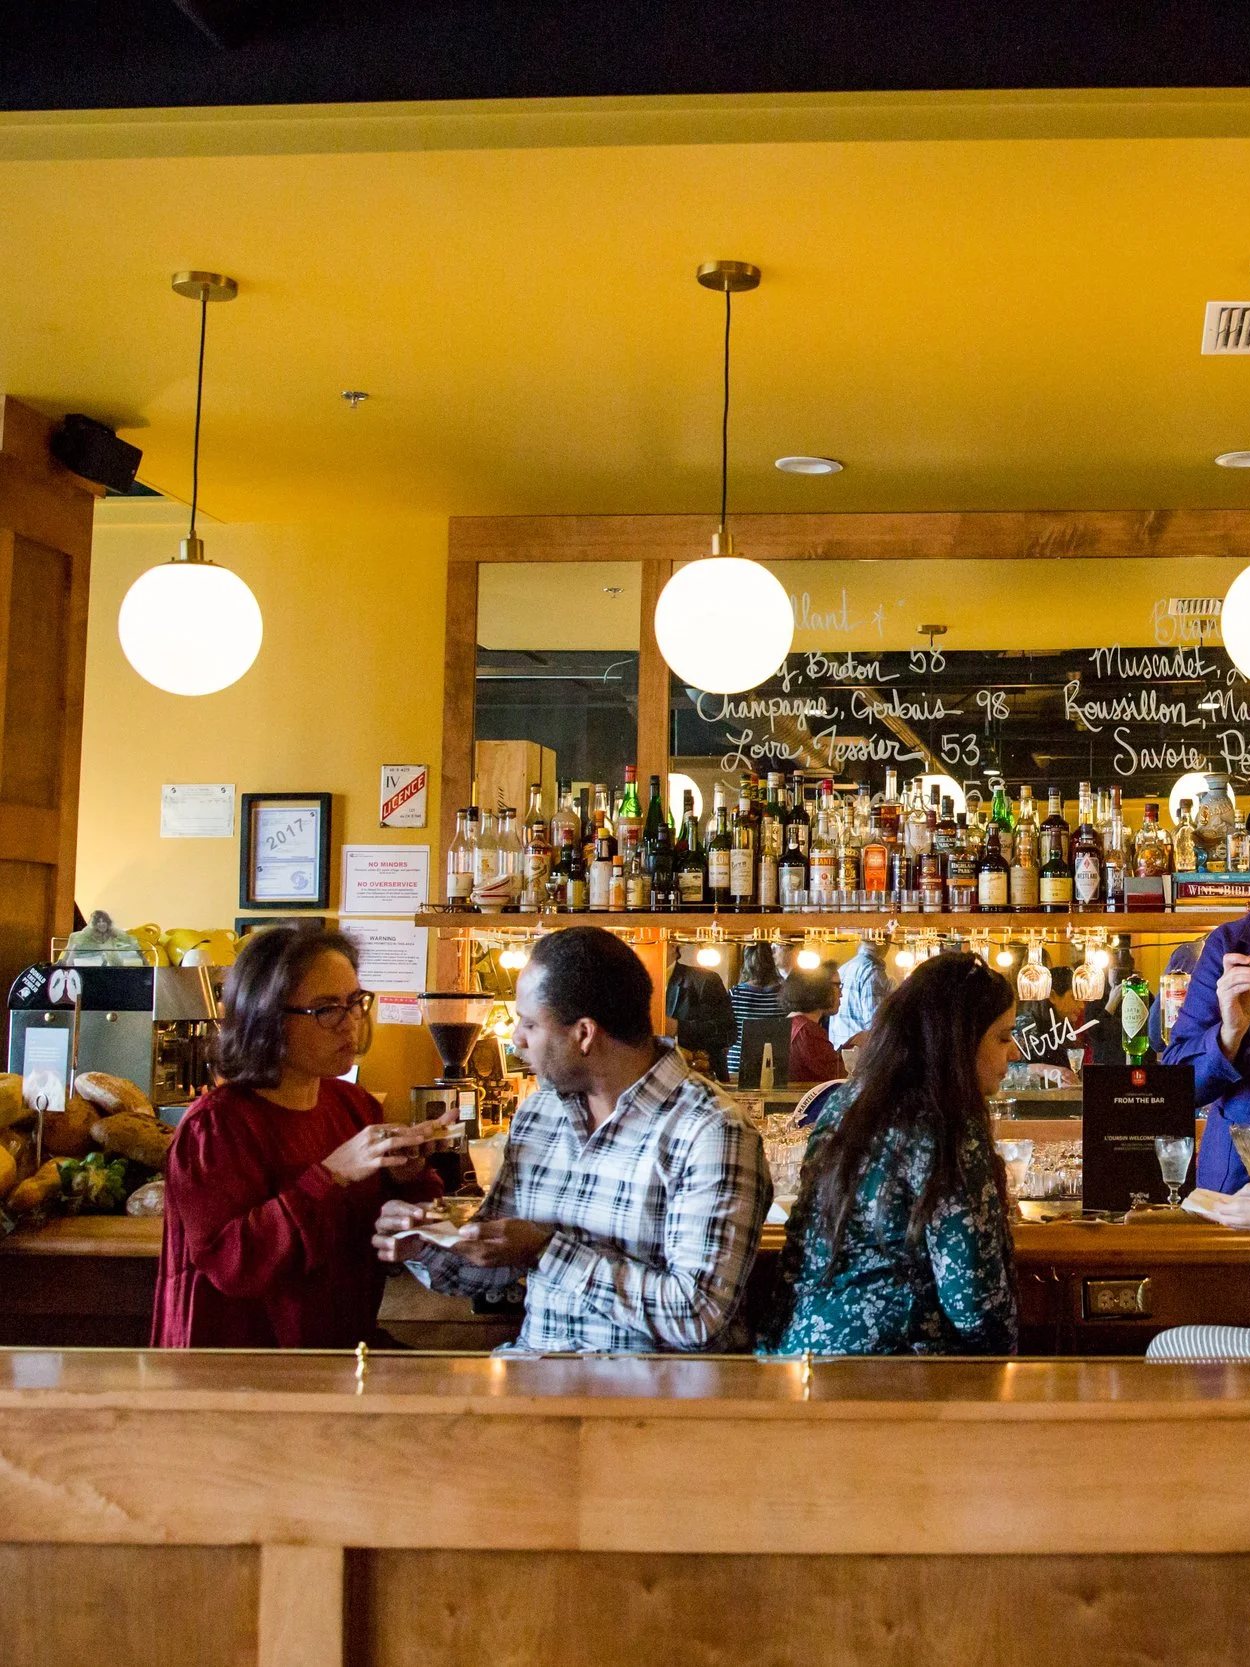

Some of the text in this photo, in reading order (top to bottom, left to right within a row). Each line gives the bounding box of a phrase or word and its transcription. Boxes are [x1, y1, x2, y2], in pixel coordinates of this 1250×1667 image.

[1150, 599, 1222, 645] Blan
[804, 649, 900, 682] Breton
[908, 646, 946, 673] 58
[1089, 644, 1221, 679] Muscadet,
[697, 691, 846, 733] Champagne,
[975, 690, 1010, 720] 98
[721, 729, 811, 773] Loire,
[941, 734, 981, 765] 53
[1113, 726, 1212, 776] Savoie,
[383, 775, 424, 818] LICENCE
[386, 775, 401, 788] IV
[266, 818, 305, 850] 2017
[1188, 884, 1216, 896] WINE
[1012, 1007, 1100, 1061] Verts
[1044, 1069, 1063, 1090] 19
[797, 1091, 818, 1113] MARTELL
